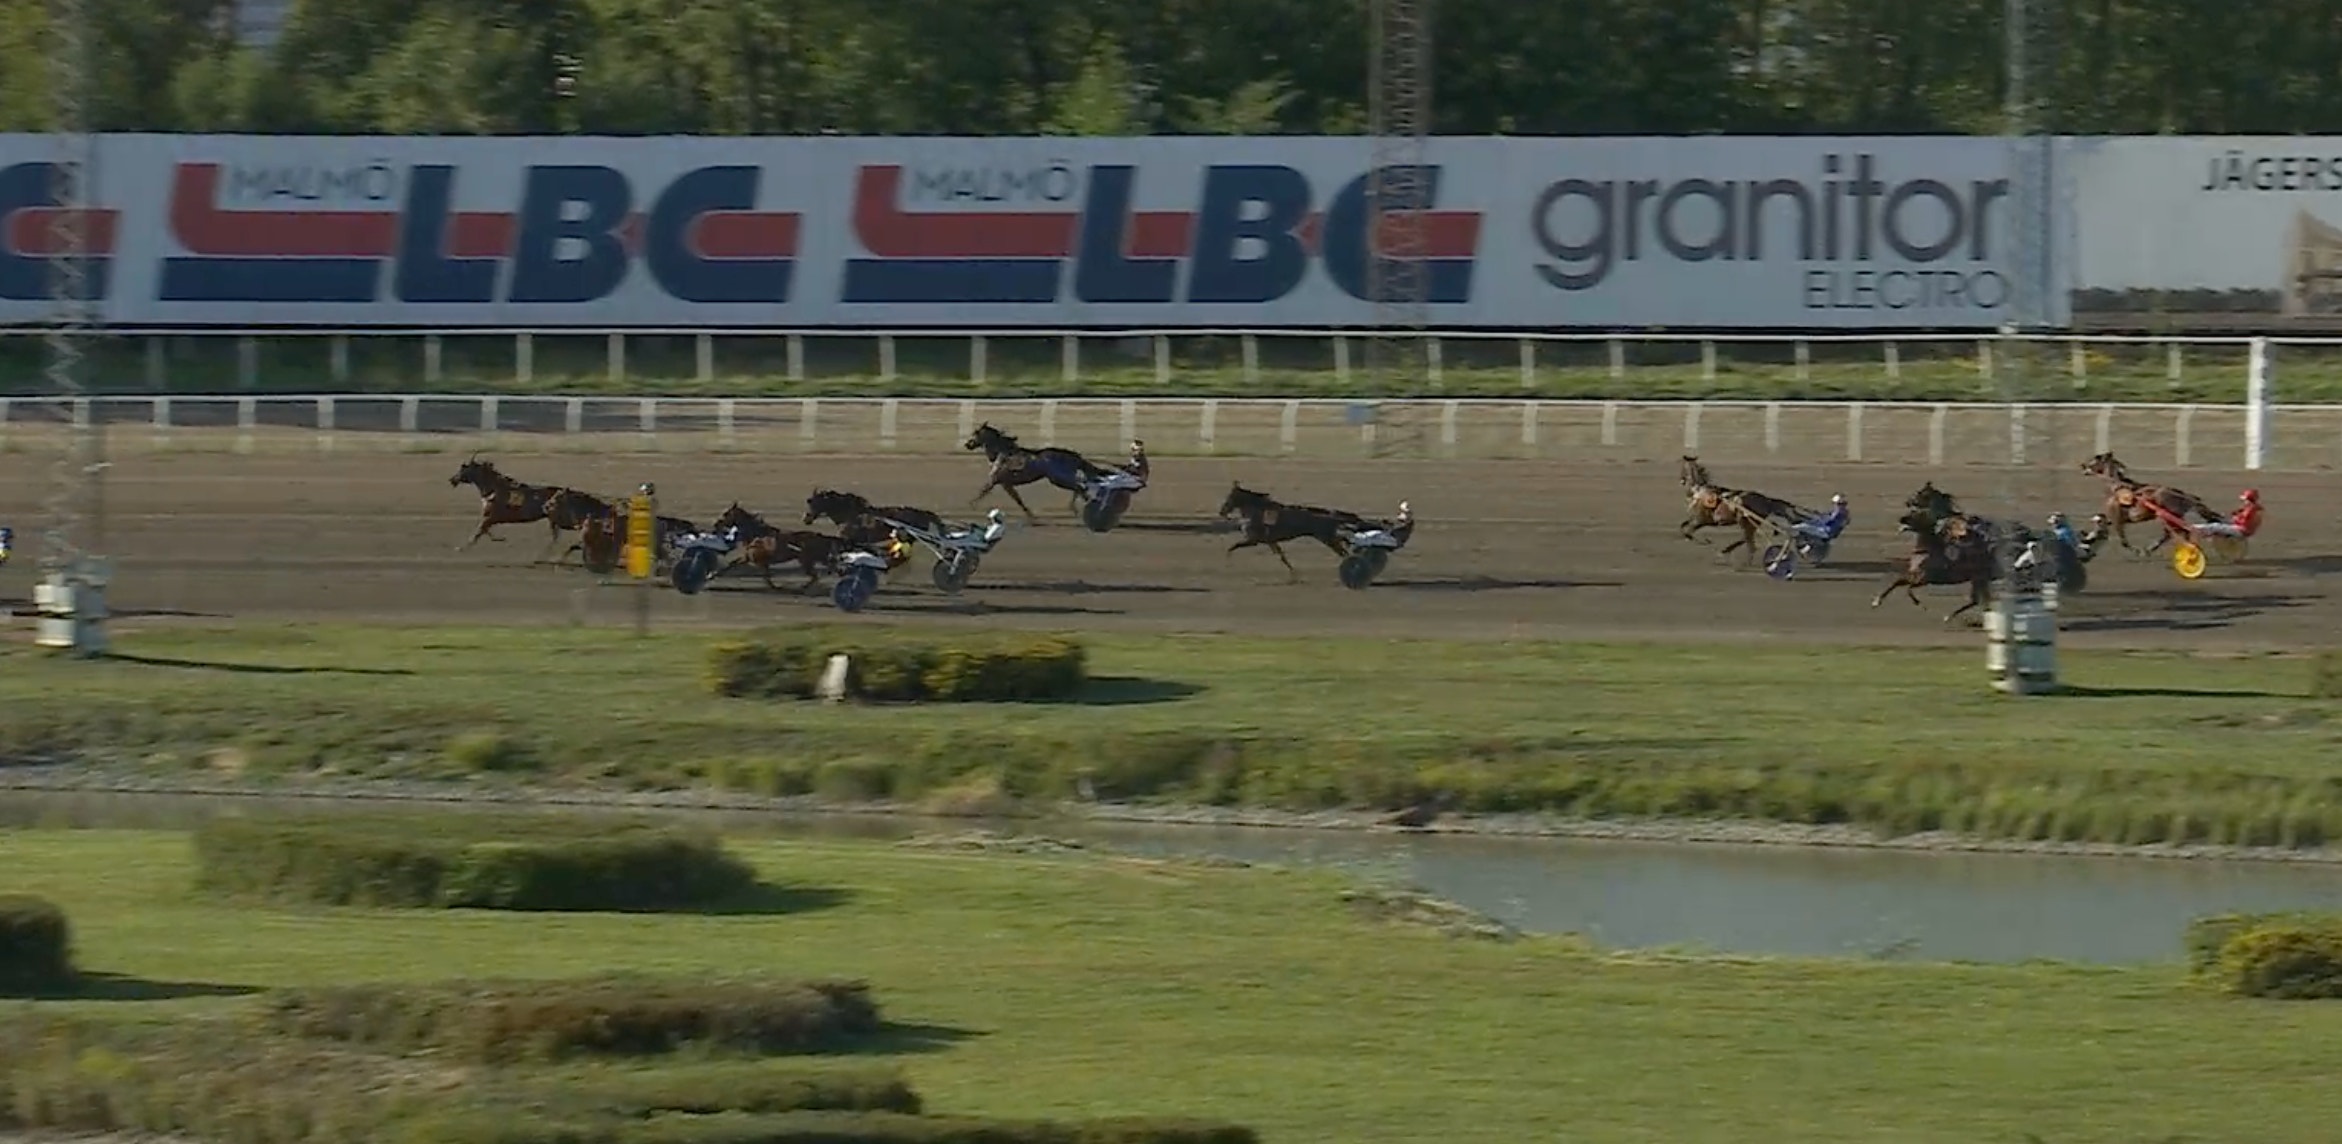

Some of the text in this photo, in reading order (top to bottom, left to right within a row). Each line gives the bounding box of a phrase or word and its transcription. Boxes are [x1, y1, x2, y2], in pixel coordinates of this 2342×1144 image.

[228, 157, 396, 201] MALMÖ
[909, 157, 1079, 202] MALMÖ
[1532, 154, 2010, 291] granitor
[1804, 269, 2010, 309] ELECTRO
